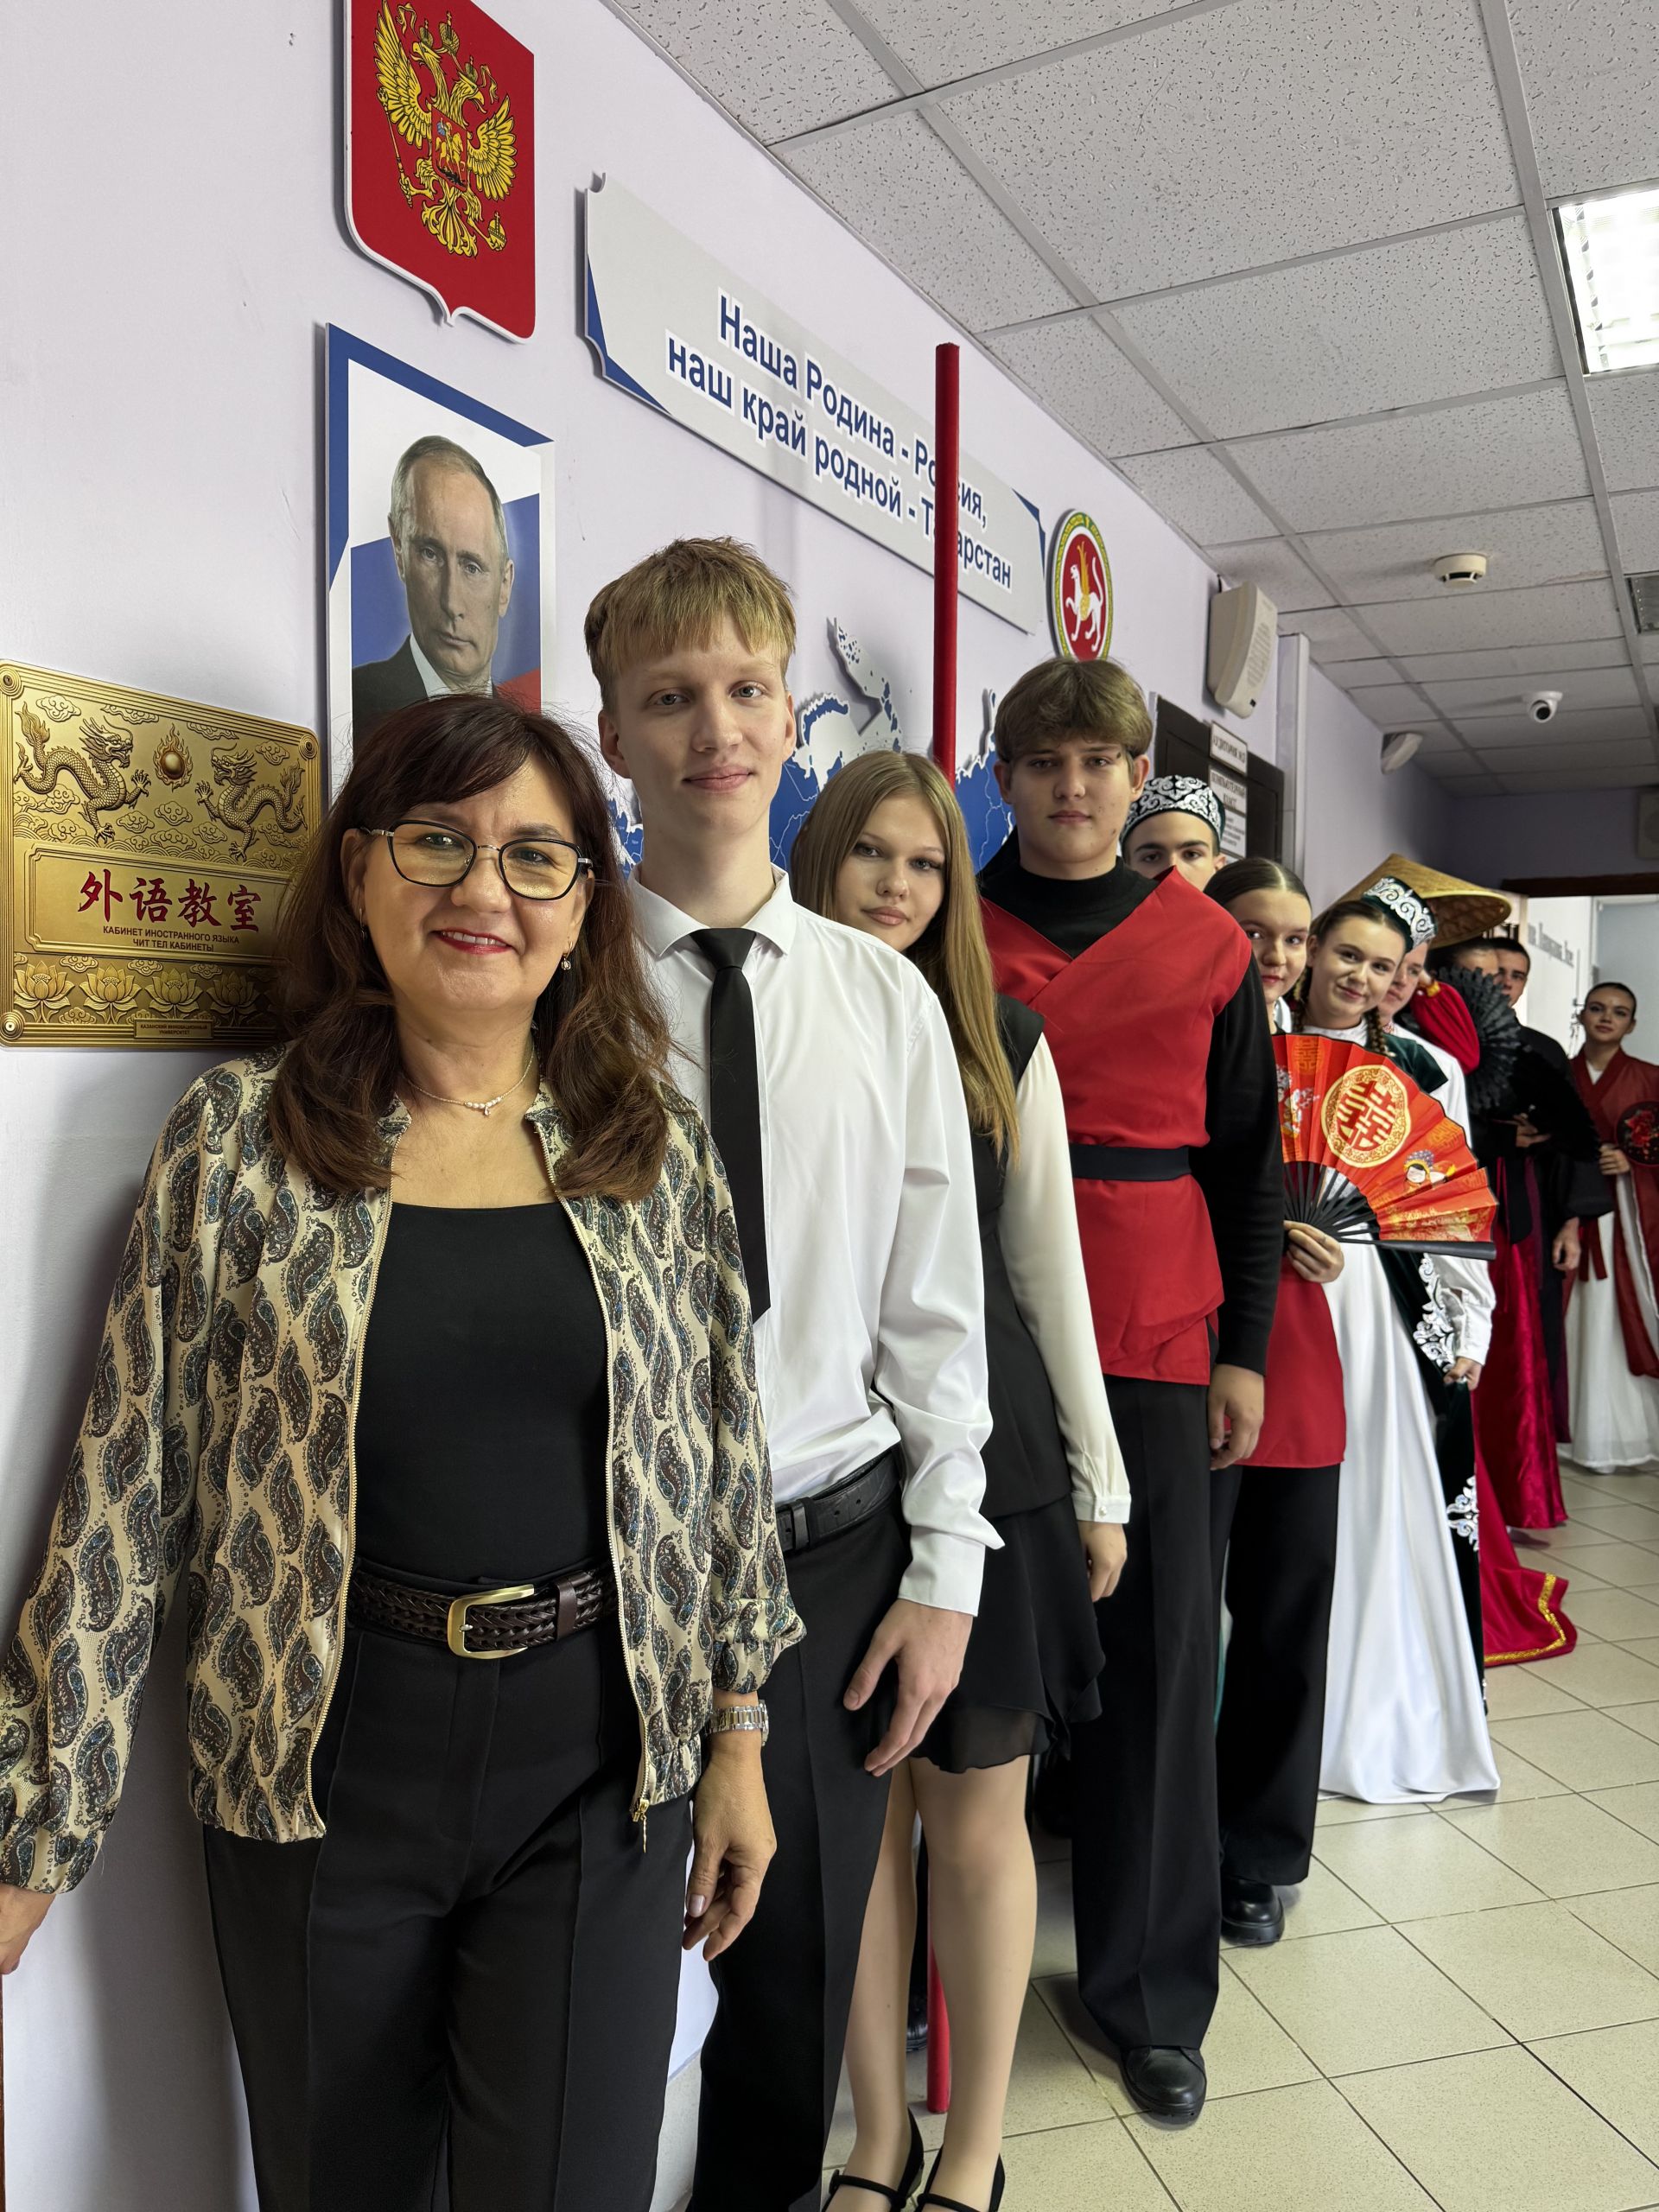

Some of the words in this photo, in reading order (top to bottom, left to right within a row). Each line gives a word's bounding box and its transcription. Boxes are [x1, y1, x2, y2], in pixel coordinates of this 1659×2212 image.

[721, 294, 798, 390] Наша
[807, 359, 894, 458] Родина
[914, 439, 987, 529] Роия,
[669, 337, 732, 409] наш
[743, 386, 806, 457] край
[815, 435, 901, 518] родной
[920, 497, 1011, 589] Тарстан
[77, 868, 262, 932] 外语教室
[103, 925, 143, 937] КАБИНЕТ
[145, 927, 211, 941] ИНОСТРАННОГО
[212, 934, 239, 944] ЯЗЫКА
[133, 938, 149, 947] ЧИТ
[151, 939, 168, 949] ТЕЛ
[170, 941, 214, 952] КАБИНЕТЫ
